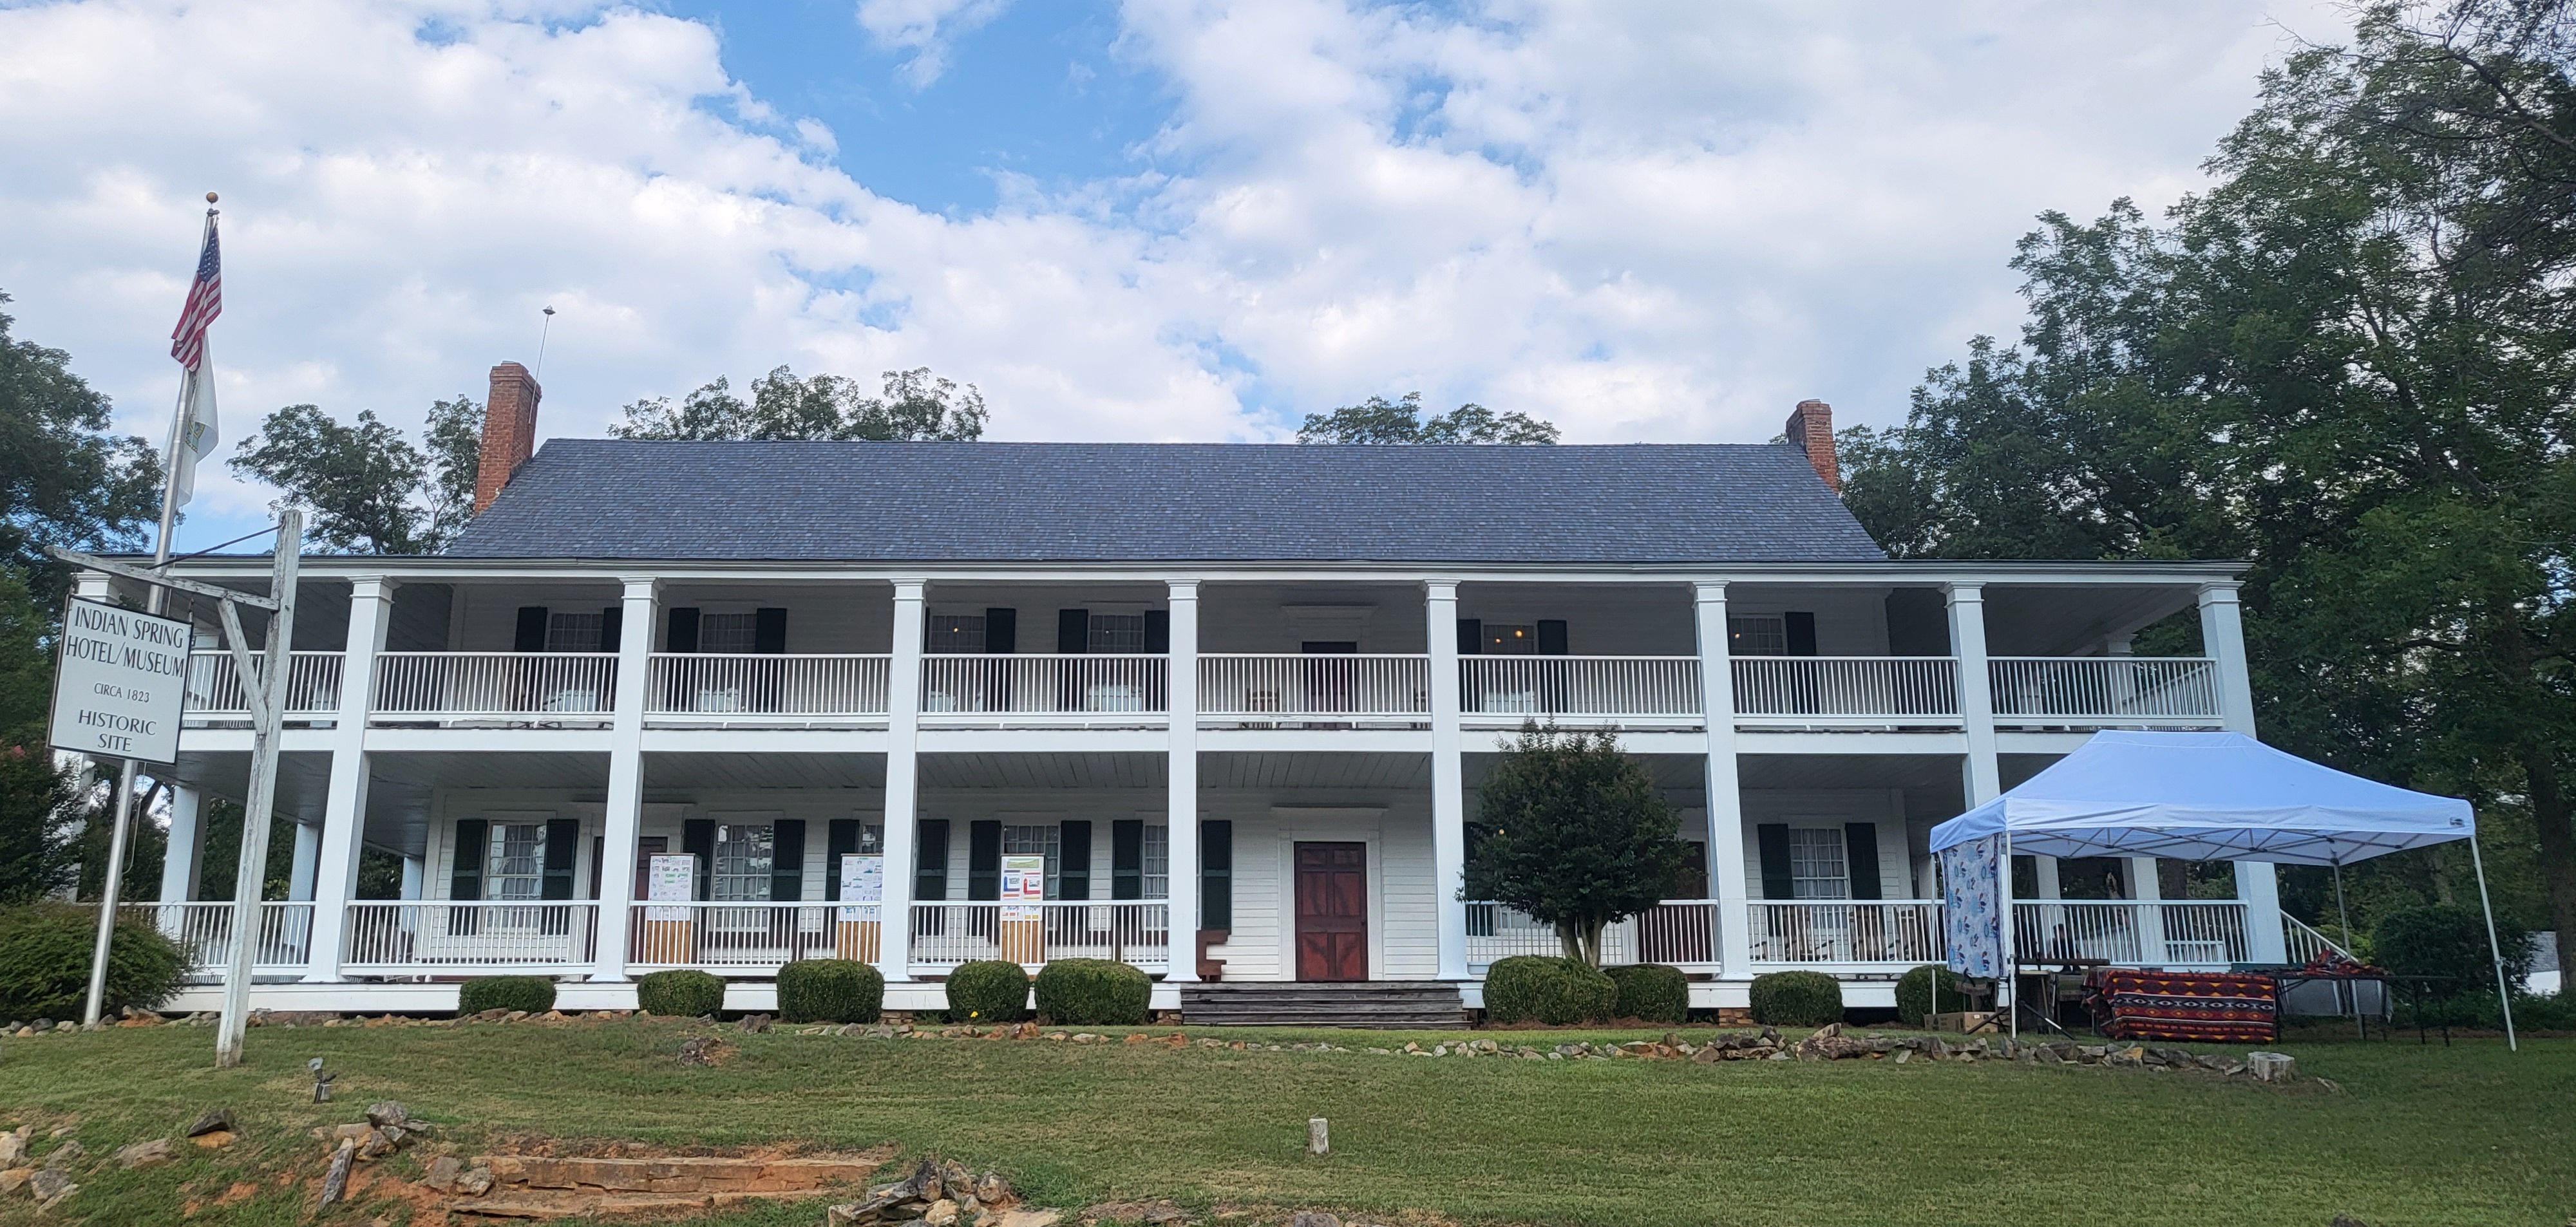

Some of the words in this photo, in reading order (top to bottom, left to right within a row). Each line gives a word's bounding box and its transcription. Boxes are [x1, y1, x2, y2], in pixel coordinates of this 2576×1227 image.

[74, 606, 129, 637] INDIAN
[133, 619, 184, 648] SPRING
[65, 635, 185, 678] HOTEL/MUSEUM
[93, 682, 122, 698] CIRCA
[127, 689, 150, 703] 1823
[78, 709, 157, 736] HISTORIC
[97, 733, 133, 752] SITE
